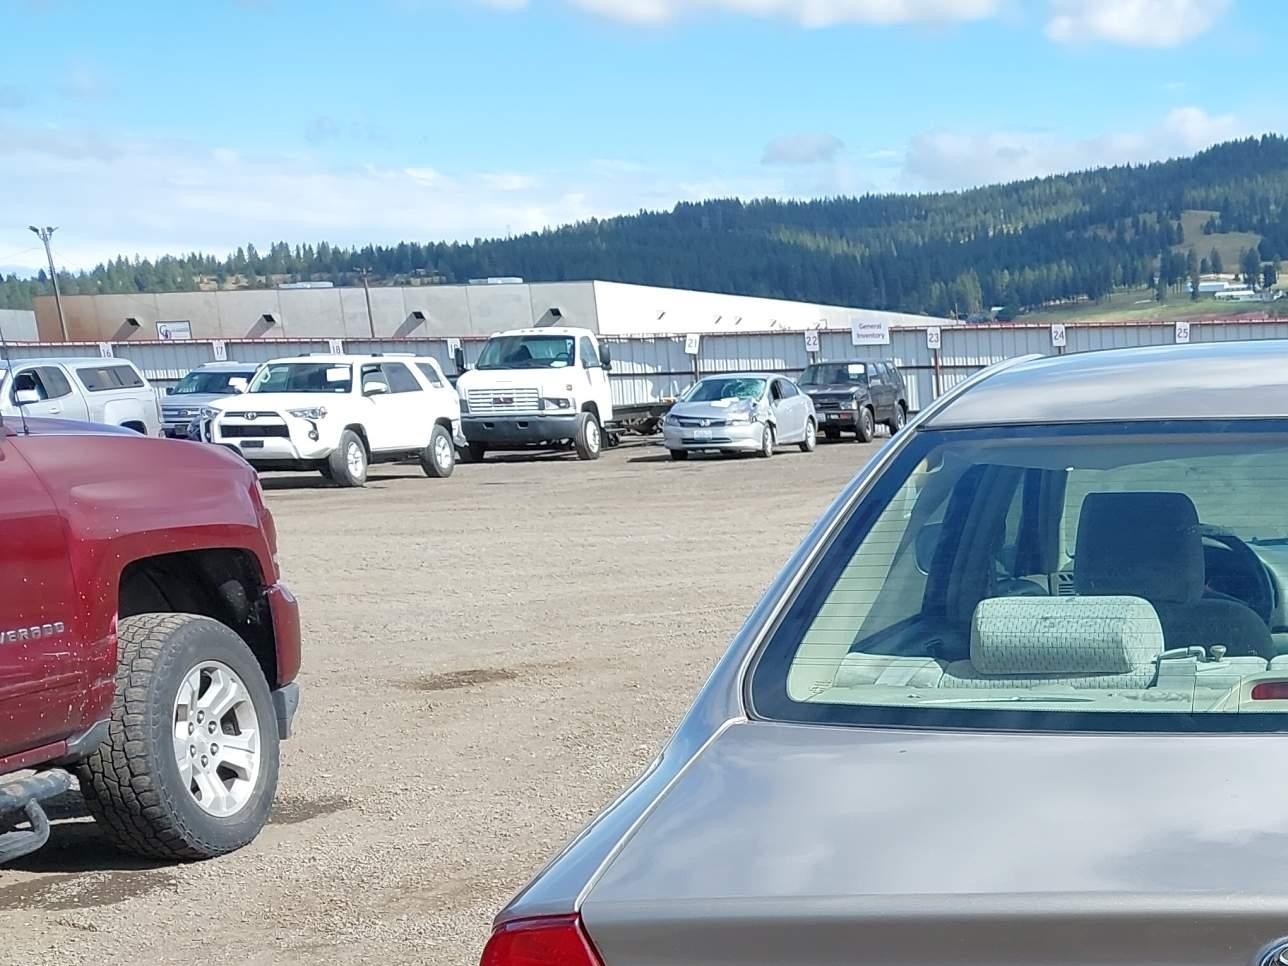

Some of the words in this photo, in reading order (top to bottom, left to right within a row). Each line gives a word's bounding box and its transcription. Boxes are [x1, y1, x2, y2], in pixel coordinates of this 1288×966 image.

[857, 332, 885, 340] Inventory
[928, 333, 939, 343] 23
[1053, 330, 1064, 341] 24
[1176, 328, 1189, 338] 25
[688, 338, 698, 348] 21
[806, 336, 818, 346] 22
